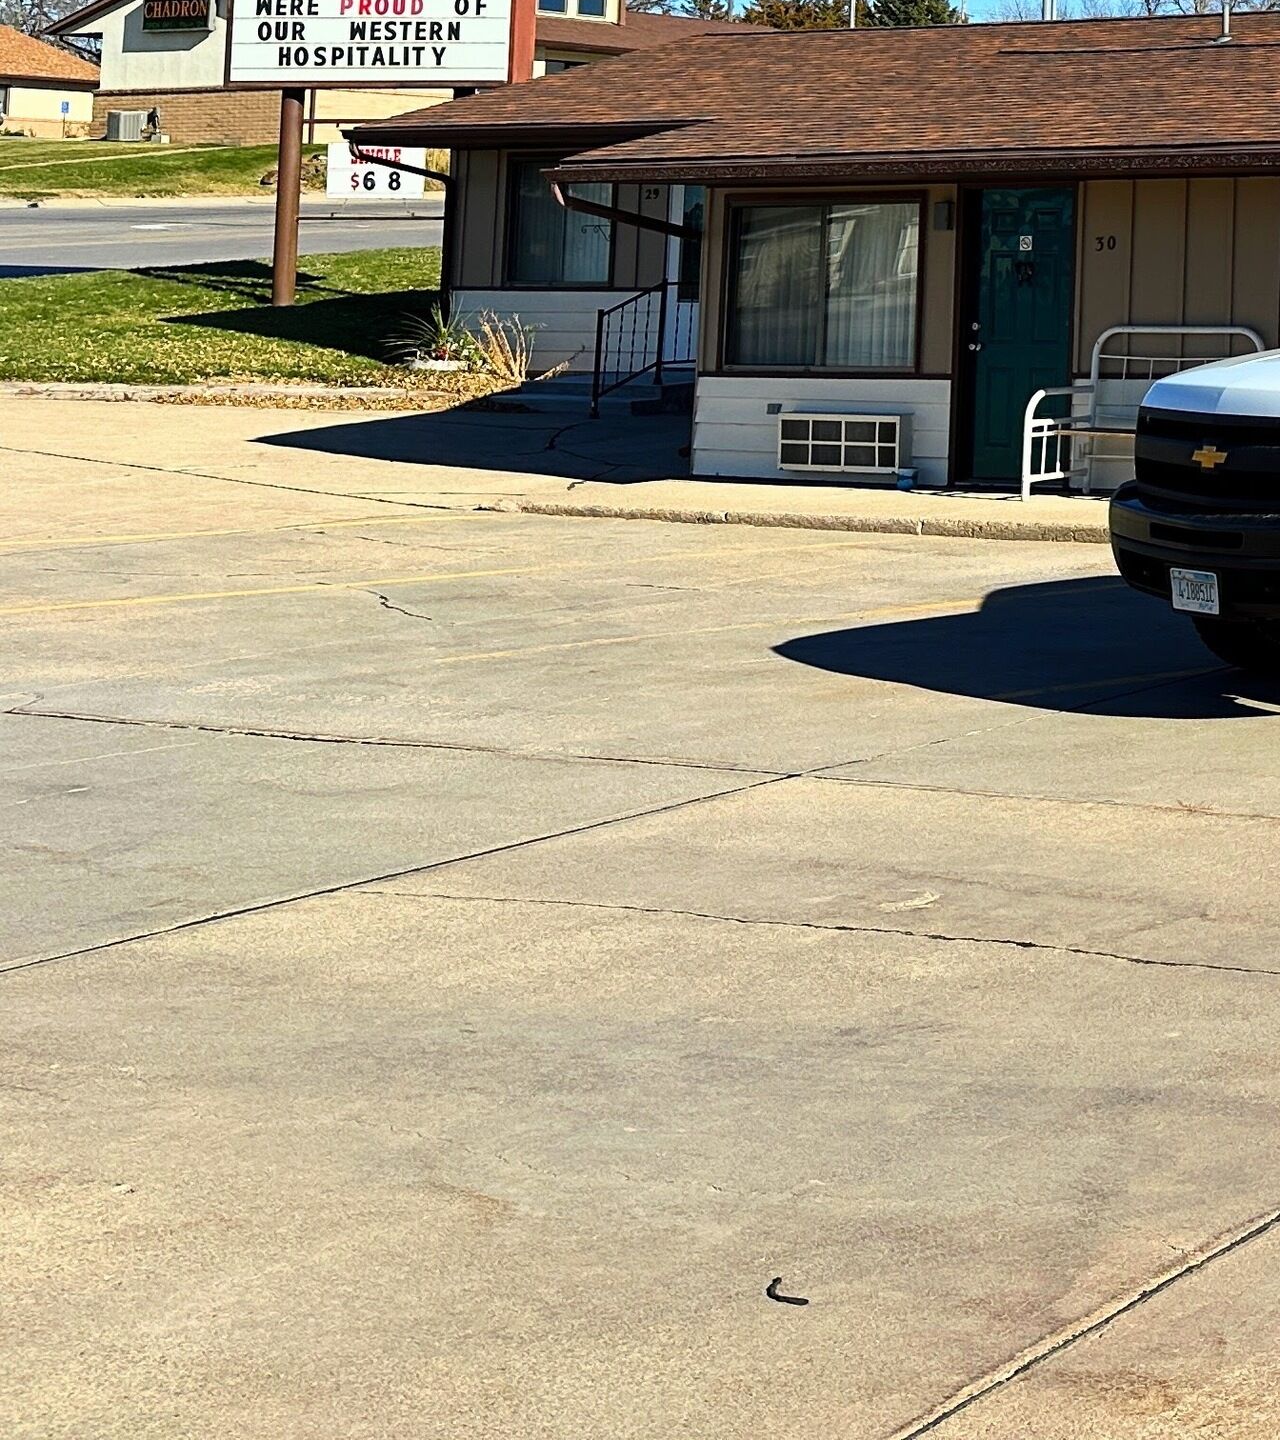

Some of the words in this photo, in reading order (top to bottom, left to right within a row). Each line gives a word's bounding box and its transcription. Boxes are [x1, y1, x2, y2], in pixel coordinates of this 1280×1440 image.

[144, 0, 208, 18] CHADRON
[257, 21, 306, 41] OUR
[349, 21, 461, 41] WESTERN
[278, 46, 447, 67] HOSPITALITY
[645, 188, 660, 200] 29
[1095, 235, 1116, 252] 30
